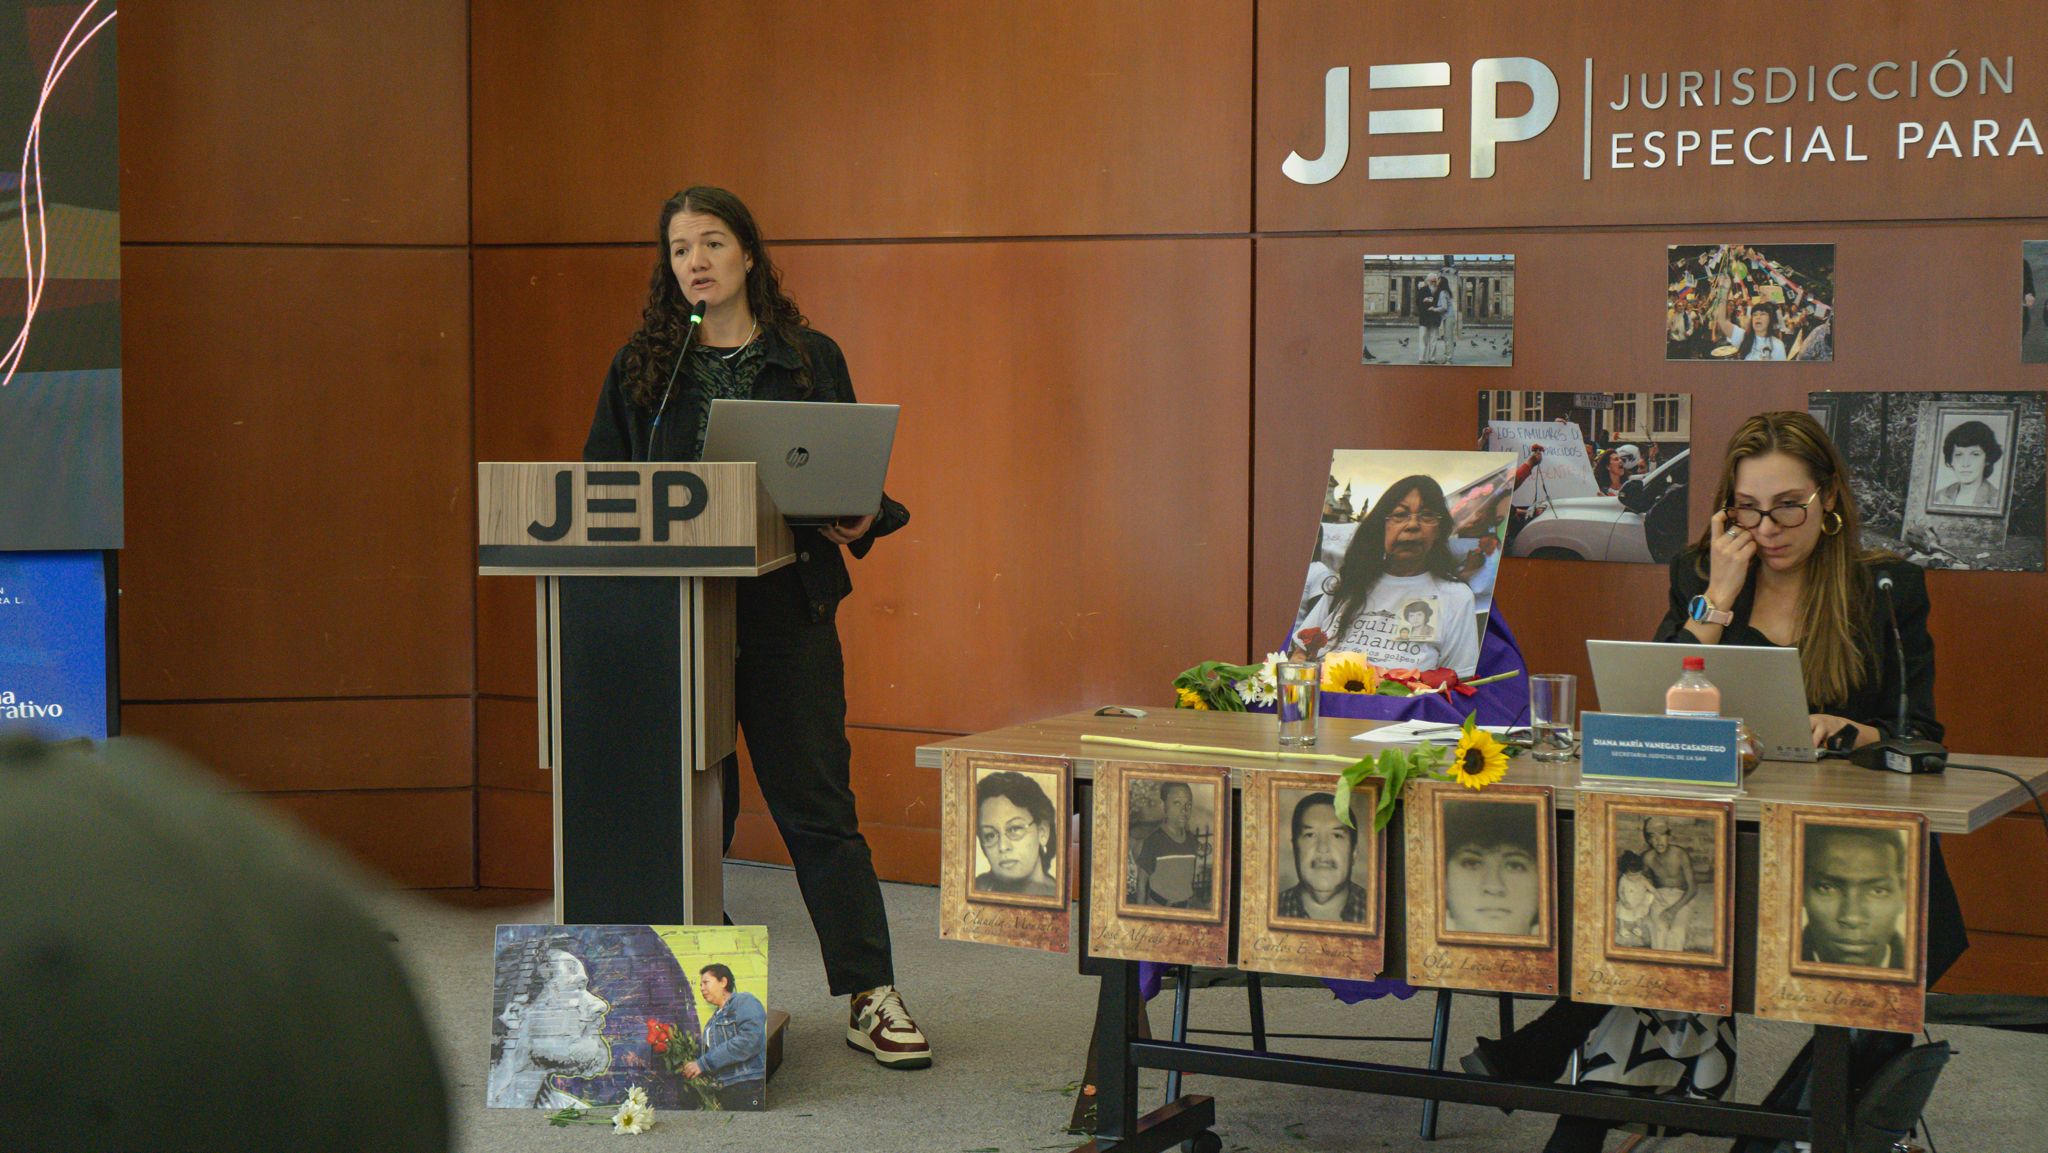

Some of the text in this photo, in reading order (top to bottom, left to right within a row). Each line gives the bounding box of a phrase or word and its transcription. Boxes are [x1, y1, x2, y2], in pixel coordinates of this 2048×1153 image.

[1609, 49, 2014, 112] JURISDICCIÓN
[1281, 56, 1560, 185] JEP
[1611, 117, 2045, 169] ESPECIAL PARA
[527, 470, 708, 542] JEP
[1593, 738, 1618, 746] DIANA
[1645, 741, 1680, 750] VANEGAS
[1681, 744, 1726, 753] CASADIEGO
